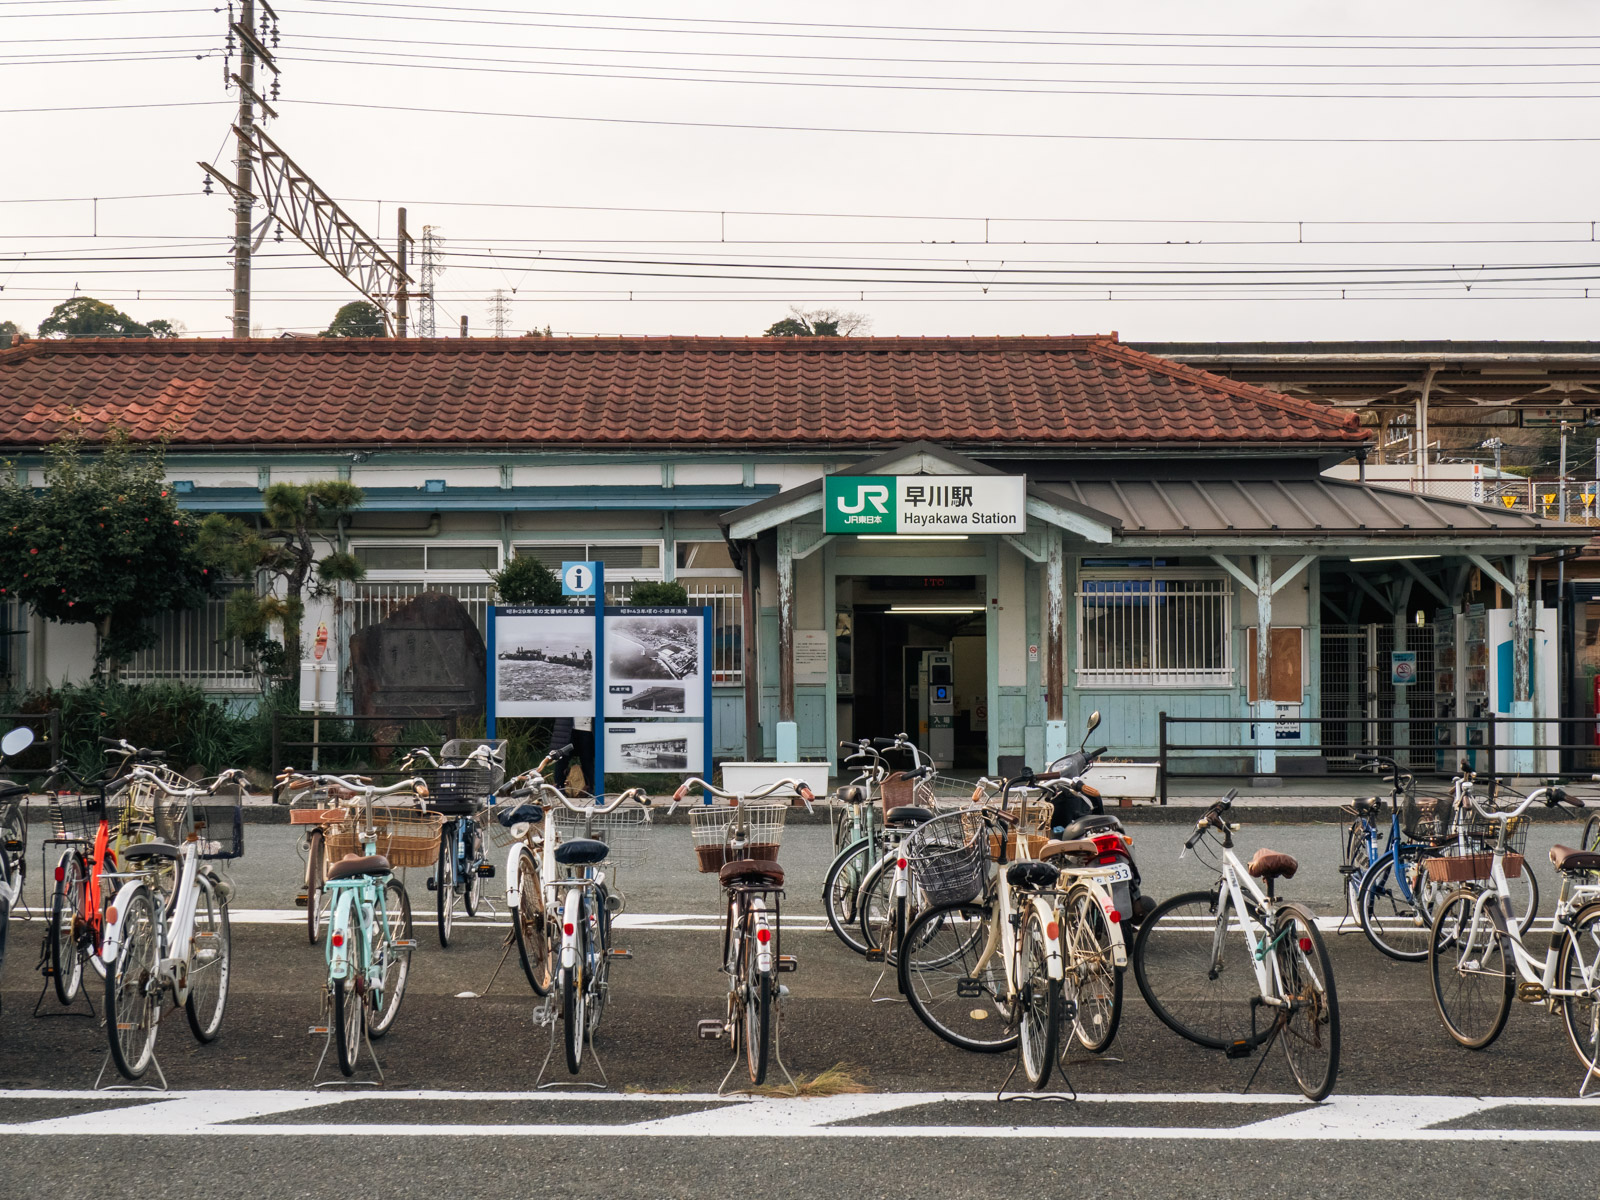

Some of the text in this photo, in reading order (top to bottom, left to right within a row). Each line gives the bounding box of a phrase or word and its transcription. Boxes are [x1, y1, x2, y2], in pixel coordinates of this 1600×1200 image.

[837, 485, 890, 514] JR
[904, 485, 974, 508] 早川駅
[844, 515, 883, 524] JR東日本
[904, 512, 1017, 527] Hayakawa Station
